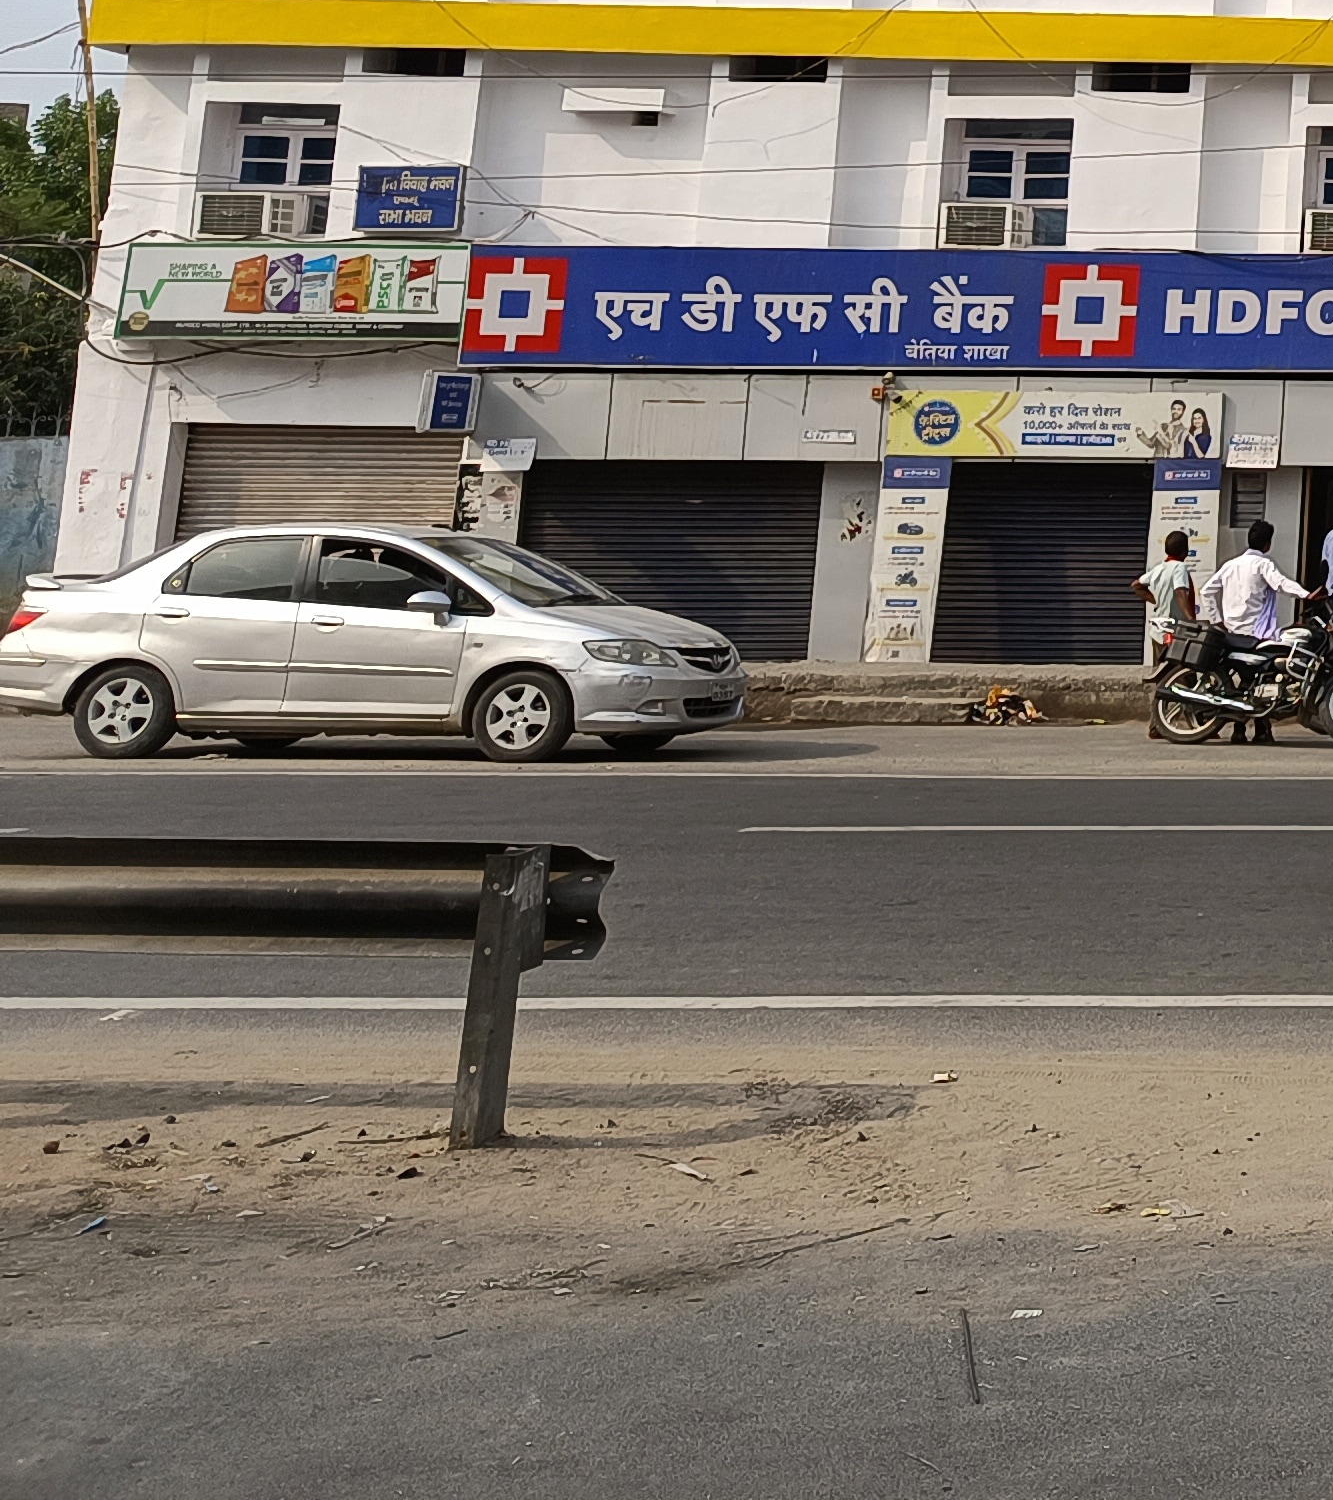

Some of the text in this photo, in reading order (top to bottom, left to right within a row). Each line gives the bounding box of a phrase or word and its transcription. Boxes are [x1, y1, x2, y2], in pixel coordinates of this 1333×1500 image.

[430, 176, 456, 191] भवन
[405, 210, 432, 223] भवन
[168, 270, 189, 278] NEW
[594, 275, 1014, 342] एच डी एफ सी बैंक
[904, 340, 1010, 361] बेतिया शाखा
[1023, 402, 1121, 418] करो हर दिल रोशन
